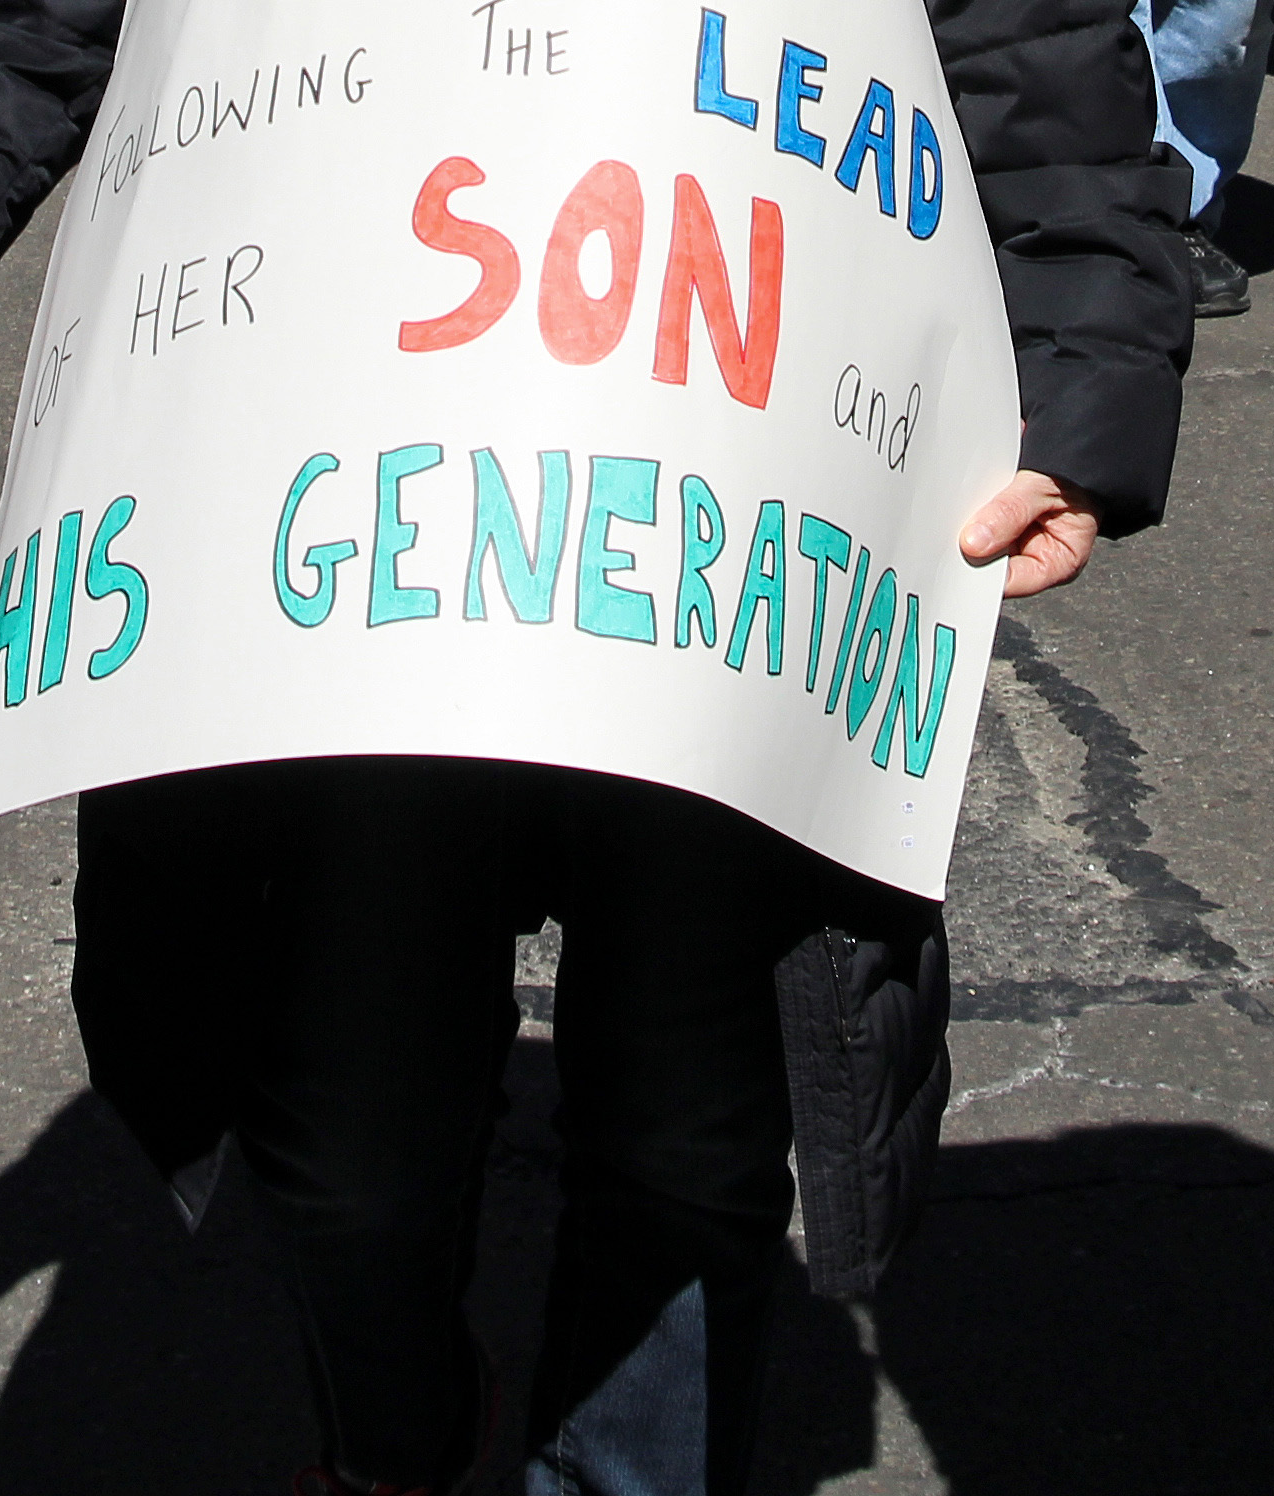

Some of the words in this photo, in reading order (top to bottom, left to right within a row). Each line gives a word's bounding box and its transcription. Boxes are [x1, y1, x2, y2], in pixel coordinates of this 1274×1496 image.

[90, 47, 373, 222] FOLLOWING
[693, 6, 944, 241] LEAD
[35, 319, 79, 429] OF
[130, 242, 265, 357] HER
[397, 155, 784, 410] SON
[835, 364, 920, 474] and
[273, 441, 957, 779] GENERATION
